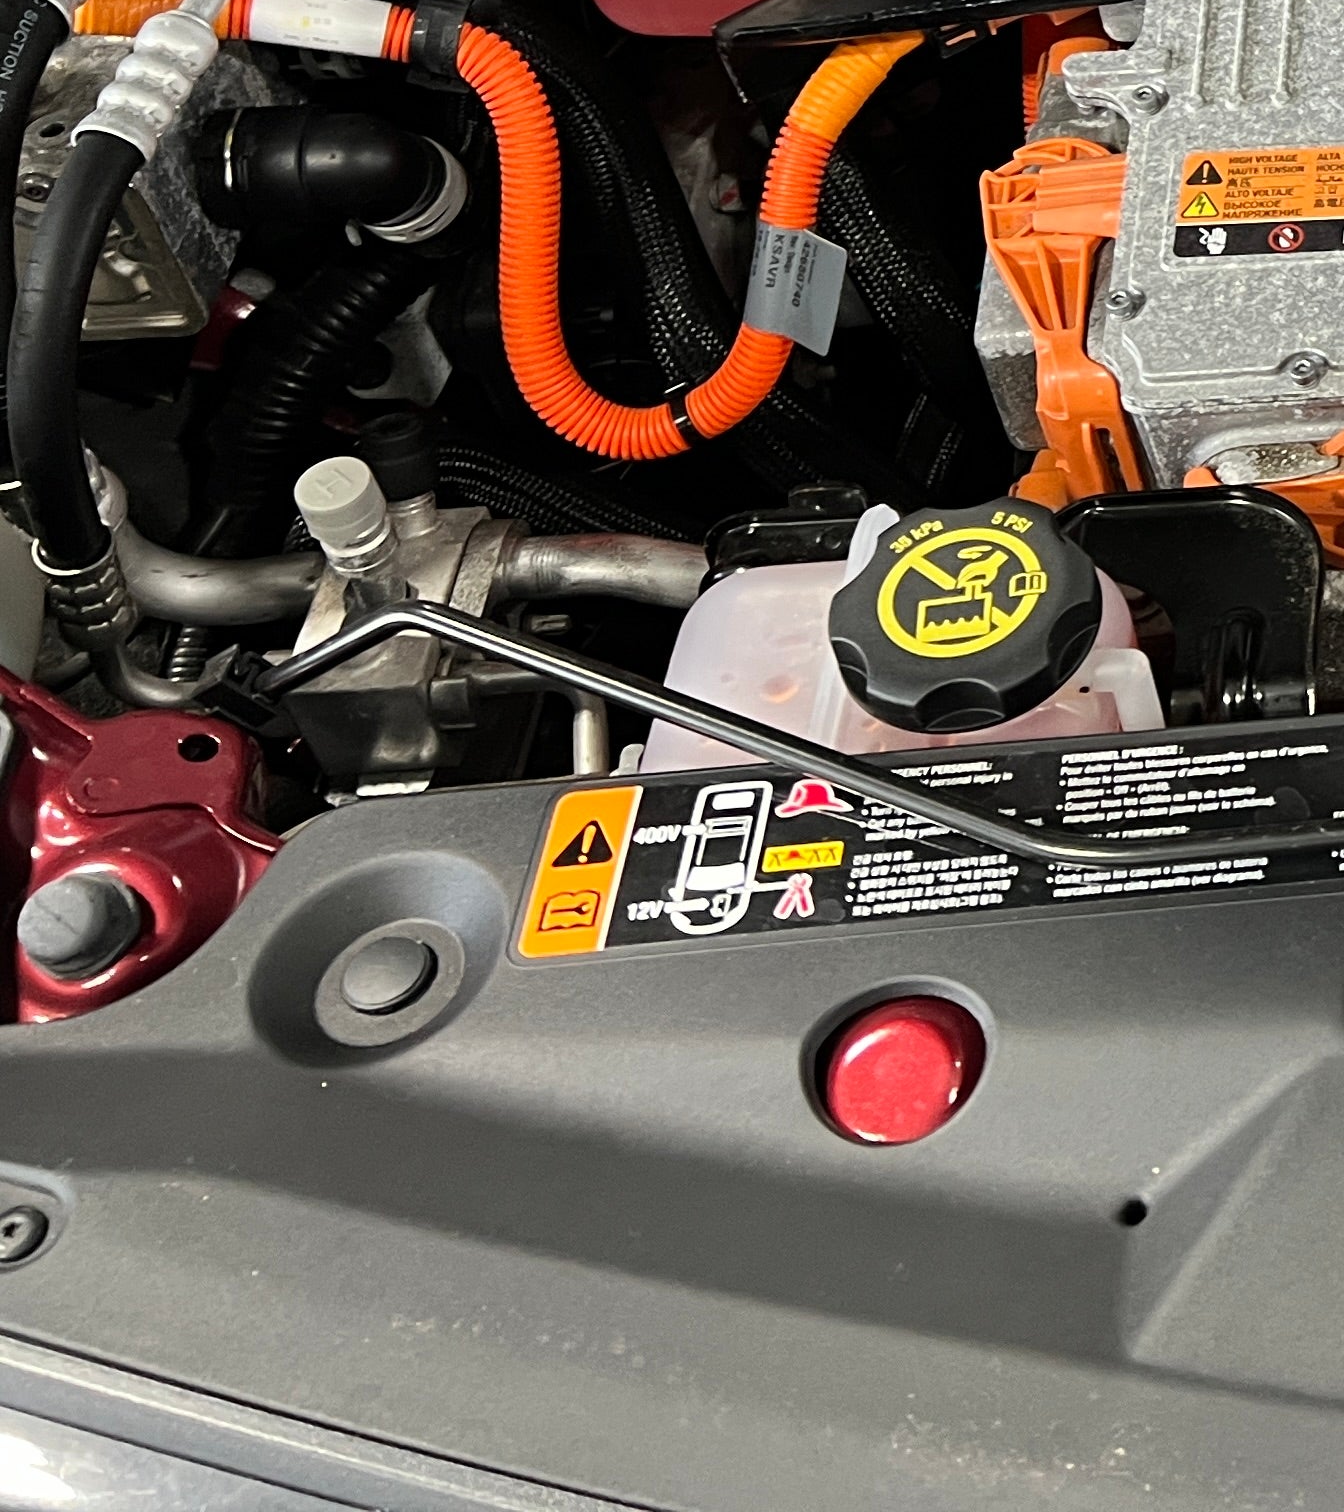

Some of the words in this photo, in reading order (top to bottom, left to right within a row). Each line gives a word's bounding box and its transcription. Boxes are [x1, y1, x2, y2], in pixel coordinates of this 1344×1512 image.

[0, 10, 38, 80] SUCTION
[1255, 154, 1299, 163] VOLTAGE
[1317, 152, 1342, 161] ALTA
[1225, 189, 1250, 198] ALTO
[1252, 188, 1295, 197] VOLTAJE
[765, 234, 785, 288] KSAVR
[909, 519, 944, 544] kPa
[991, 511, 1003, 525] 5
[1003, 513, 1034, 534] PSI
[1062, 750, 1120, 764] PERSONNEL
[632, 824, 681, 845] 400V
[627, 899, 665, 922] 12V
